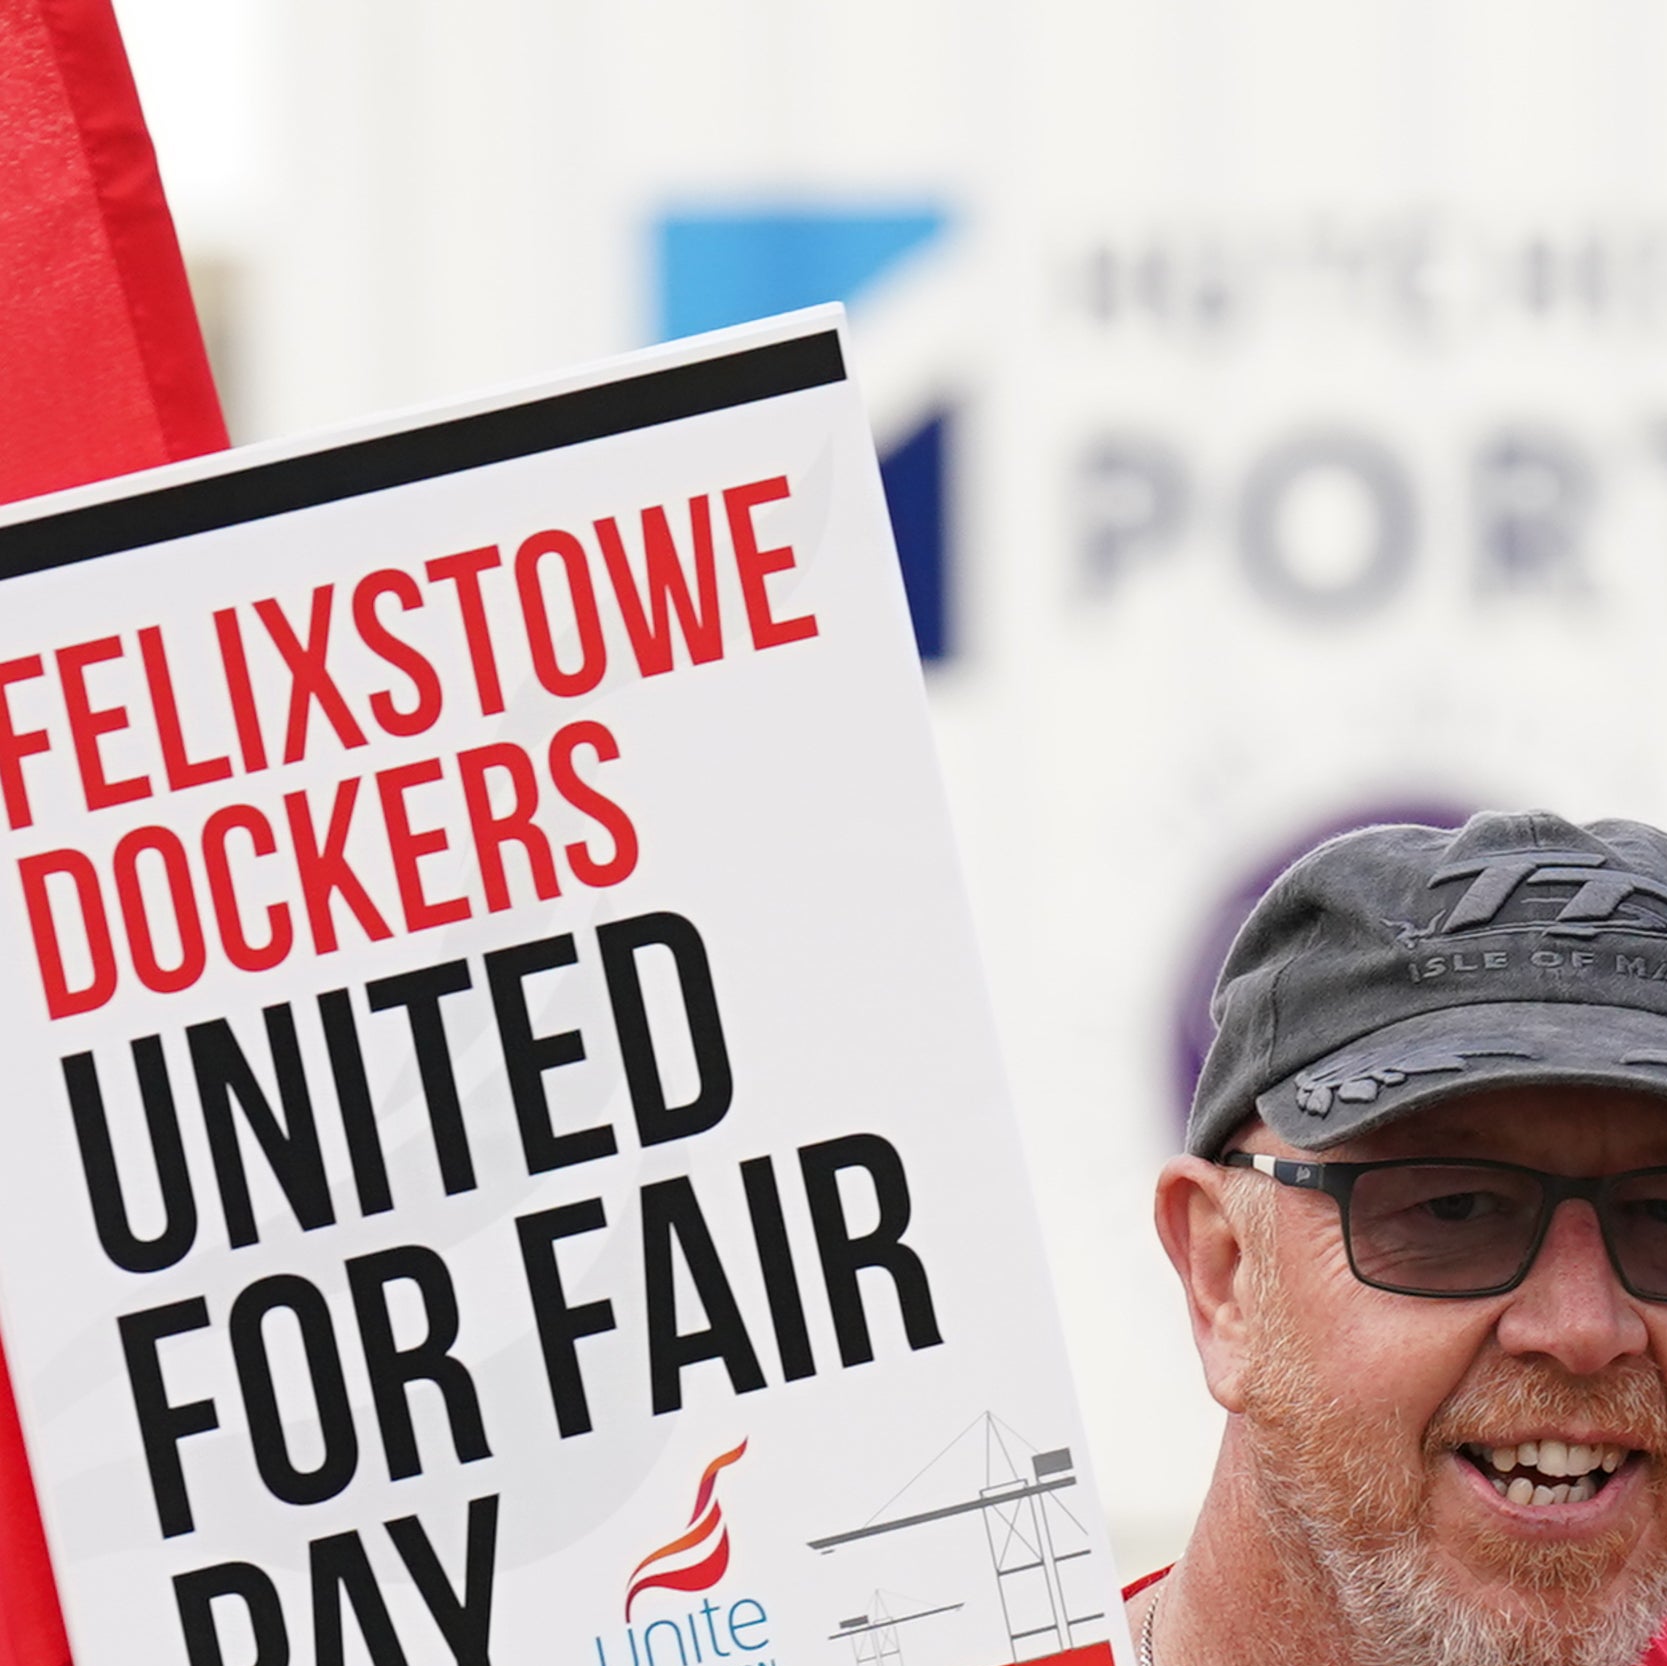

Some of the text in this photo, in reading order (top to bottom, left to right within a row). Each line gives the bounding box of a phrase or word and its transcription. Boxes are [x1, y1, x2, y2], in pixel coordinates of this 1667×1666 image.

[0, 475, 819, 831] FELIXSTOWE
[18, 720, 639, 1021] DOCKERS
[1408, 951, 1508, 984] ISLE
[1531, 950, 1596, 969] OF
[62, 911, 732, 1274] UNITED
[118, 1133, 944, 1539] FOR FAIR
